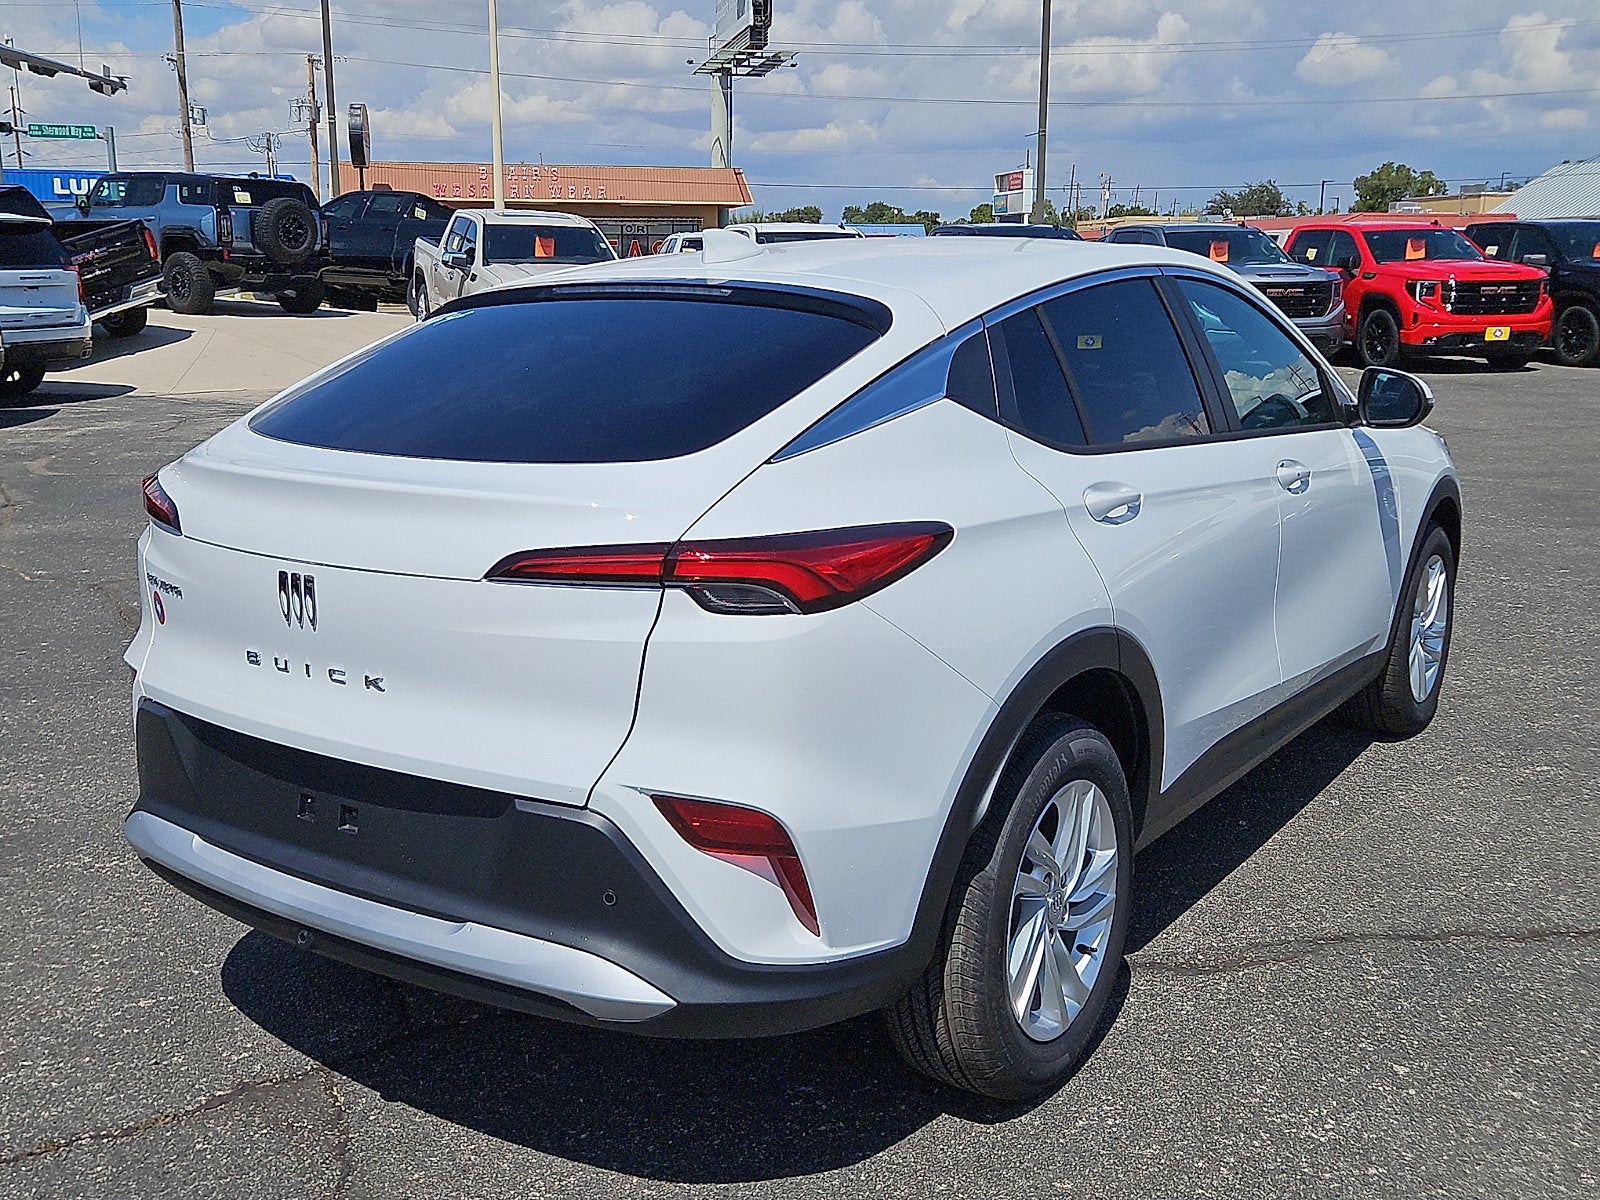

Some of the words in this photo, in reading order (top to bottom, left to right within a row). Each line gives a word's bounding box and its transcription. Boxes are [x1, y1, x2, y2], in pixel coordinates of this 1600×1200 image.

[42, 125, 69, 136] Sherwood
[70, 126, 82, 139] Way
[479, 166, 559, 181] BAIR'S
[433, 183, 535, 199] WESTRN
[548, 185, 607, 200] WEAR
[246, 650, 386, 693] BUICK
